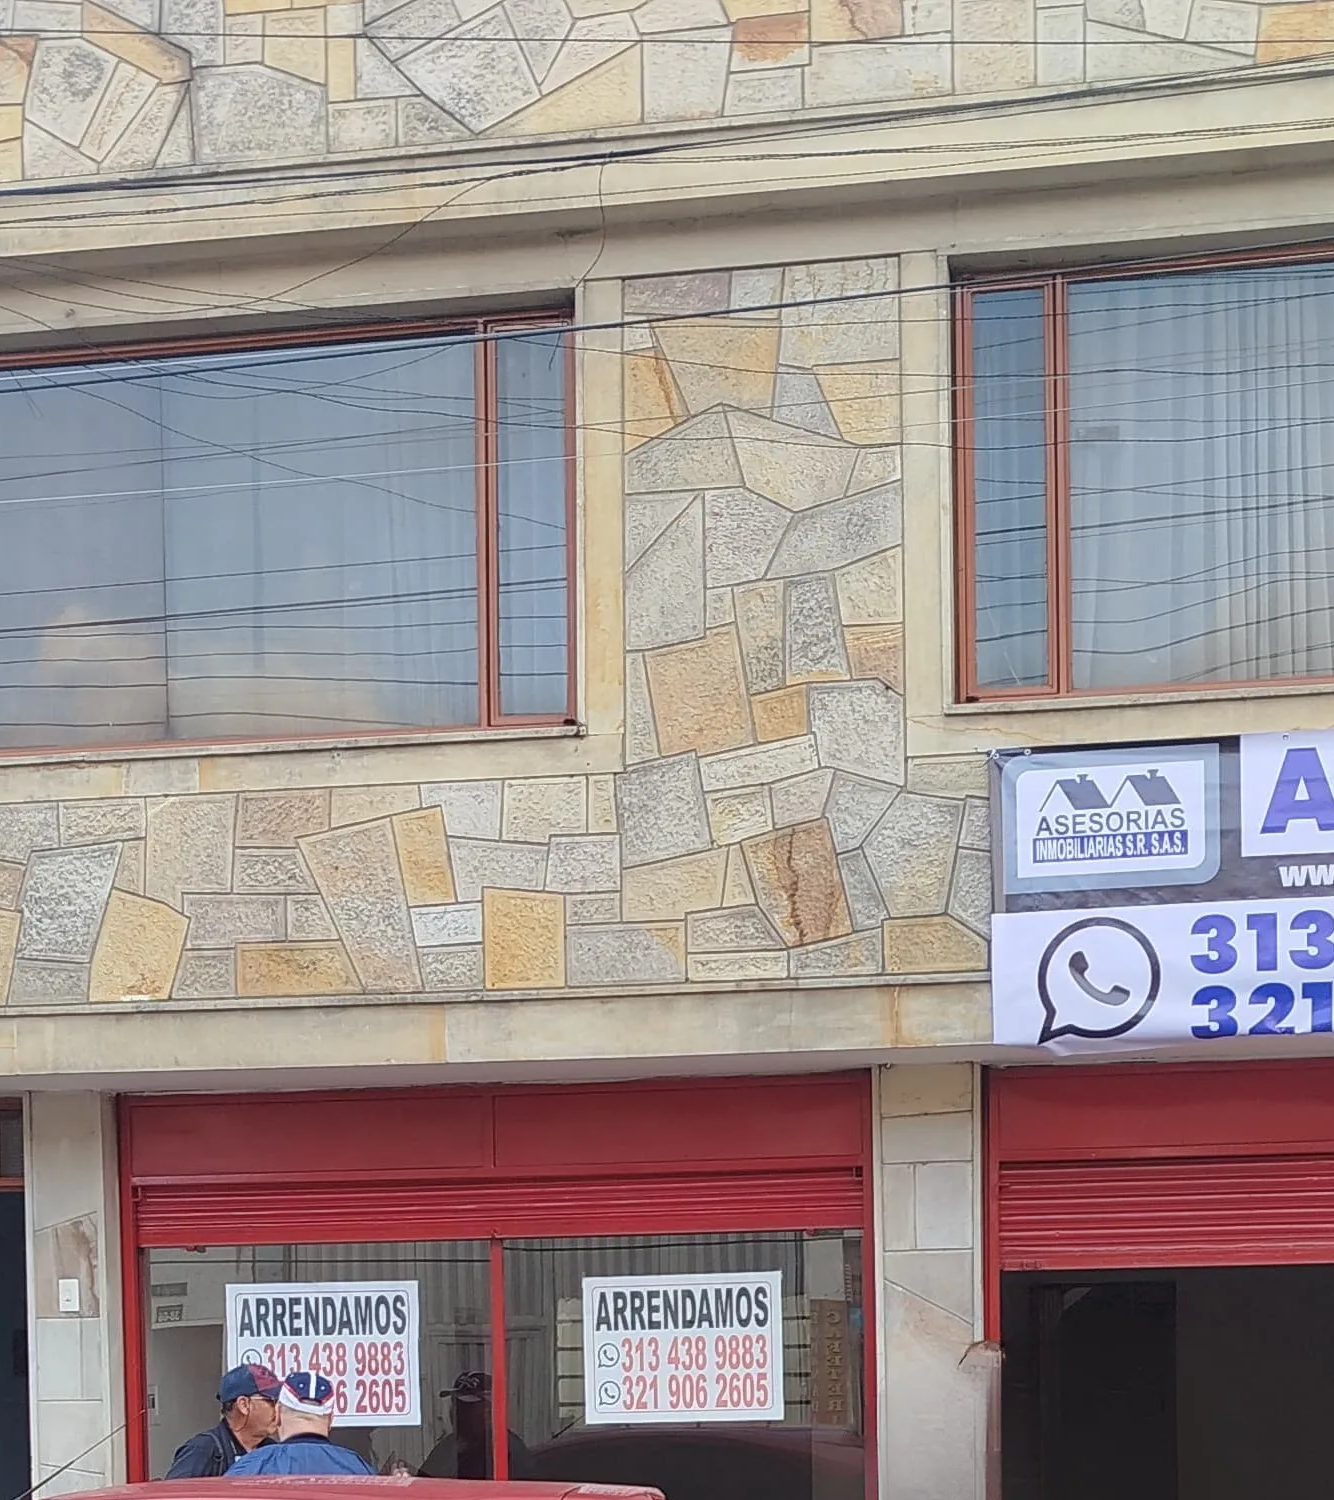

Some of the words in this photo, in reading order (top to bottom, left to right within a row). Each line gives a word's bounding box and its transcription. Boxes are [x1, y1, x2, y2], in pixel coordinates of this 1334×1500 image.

[1036, 808, 1185, 836] ASESORIAS
[1036, 836, 1124, 861] INMOBILIARIAS
[1151, 832, 1185, 854] S.A.S.
[1190, 980, 1334, 1039] 321
[239, 1294, 407, 1337] ARRENDAMOS
[595, 1286, 768, 1331] ARRENDAMOS
[264, 1342, 302, 1377] 313
[308, 1342, 347, 1377] 438
[354, 1341, 405, 1376] 9883
[621, 1337, 660, 1372] 313
[667, 1335, 707, 1370] 438
[715, 1334, 768, 1370] 9883
[355, 1379, 407, 1413] 2605
[622, 1375, 658, 1410] 321
[668, 1374, 707, 1409] 906
[716, 1372, 768, 1407] 2605
